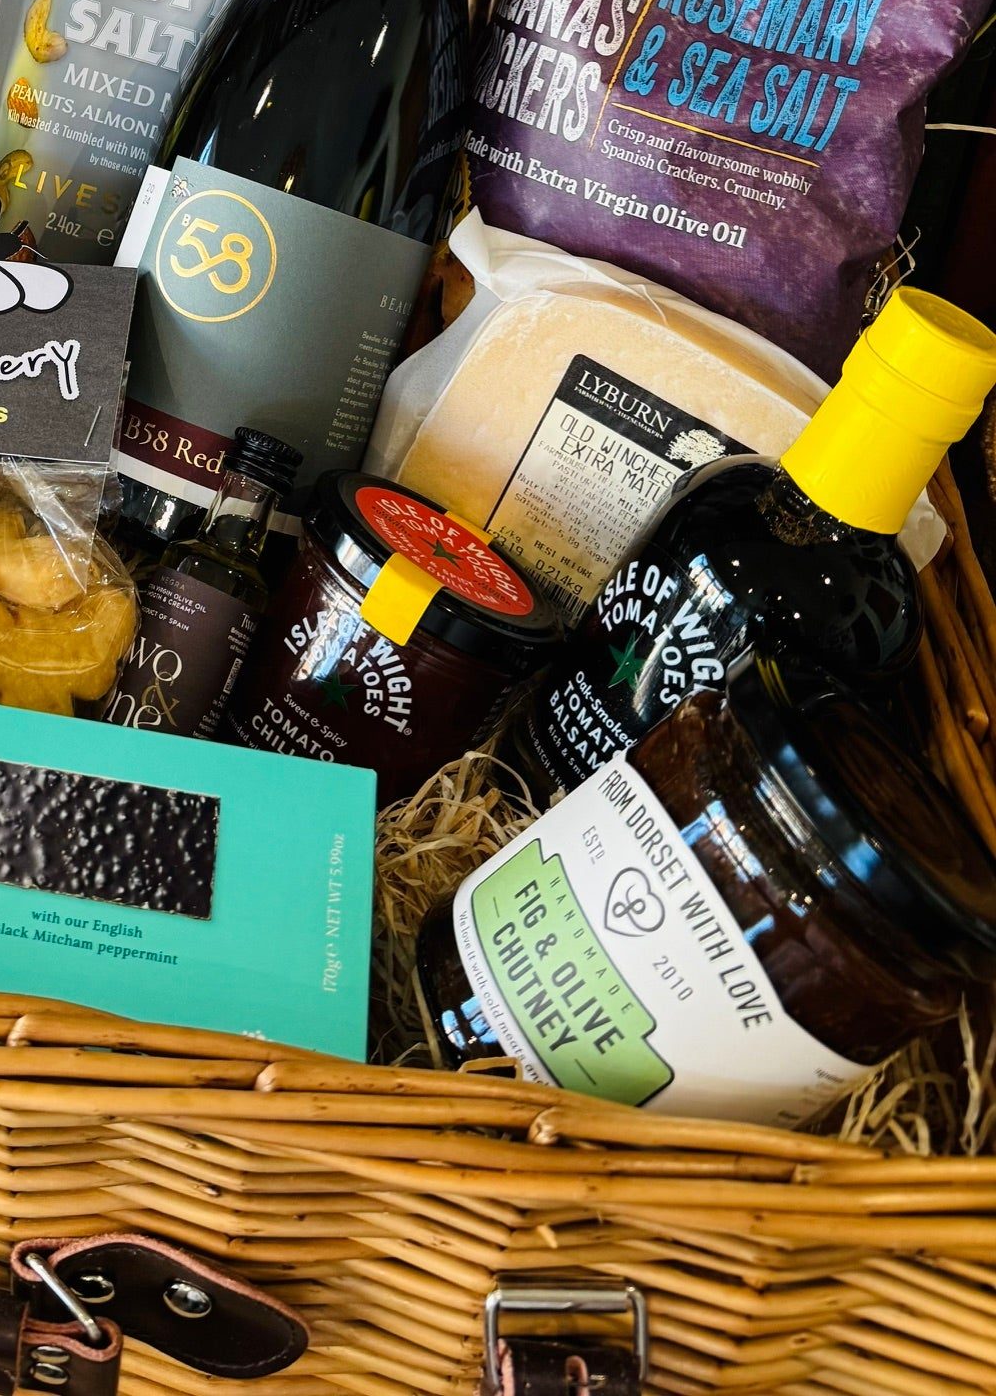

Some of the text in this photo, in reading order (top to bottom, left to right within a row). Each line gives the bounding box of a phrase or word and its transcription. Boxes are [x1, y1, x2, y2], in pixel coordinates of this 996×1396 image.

[11, 84, 78, 118] PEANUTS,
[63, 63, 156, 107] MIXED
[624, 25, 860, 152] & SEA SALT
[607, 118, 813, 196] Crisp and flavoursome wobbly
[46, 212, 82, 238] 2.4oz
[490, 142, 746, 249] with Extra Virgin Olive Oil
[578, 370, 673, 433] LYBURN
[126, 415, 224, 474] B58 Red
[561, 437, 615, 475] EXTRA
[368, 636, 412, 733] WIGHT
[263, 698, 334, 763] TOMATO
[284, 694, 347, 748] Sweet & Spicy
[598, 770, 773, 1029] FROM DORSET WITH LOVE
[32, 929, 94, 951] Mitcham
[97, 941, 178, 965] peppermint
[514, 879, 625, 1055] FIG & OLIVE
[493, 922, 578, 1054] CHUTNEY
